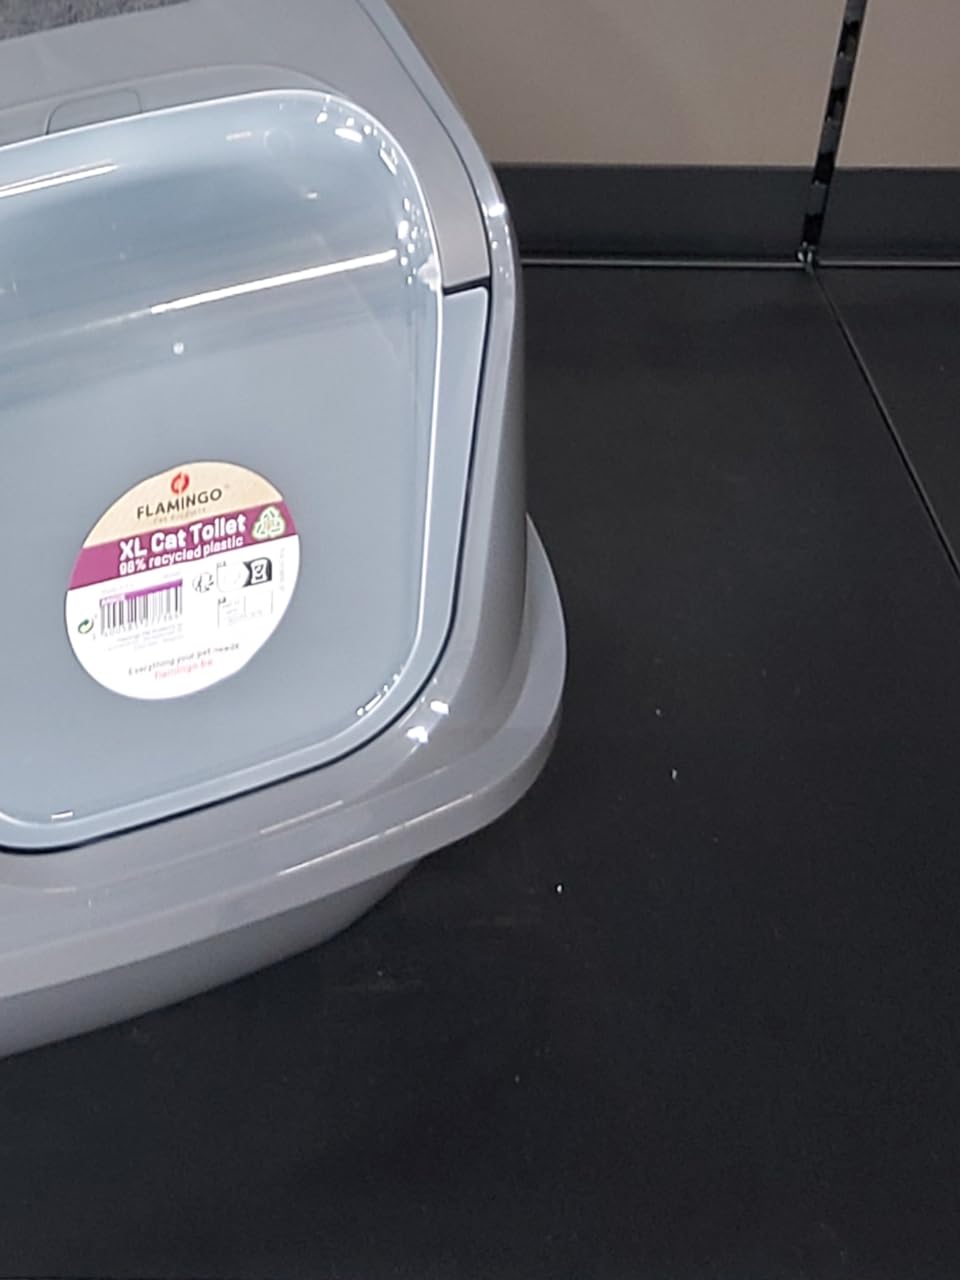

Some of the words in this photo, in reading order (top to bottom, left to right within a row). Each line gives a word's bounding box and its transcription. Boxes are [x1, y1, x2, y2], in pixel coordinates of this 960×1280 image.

[136, 487, 223, 519] FLAMINGO
[119, 537, 147, 562] XL
[150, 529, 186, 554] Cat
[189, 513, 247, 544] Toilet
[148, 547, 202, 570] recycled
[203, 535, 244, 559] plastic
